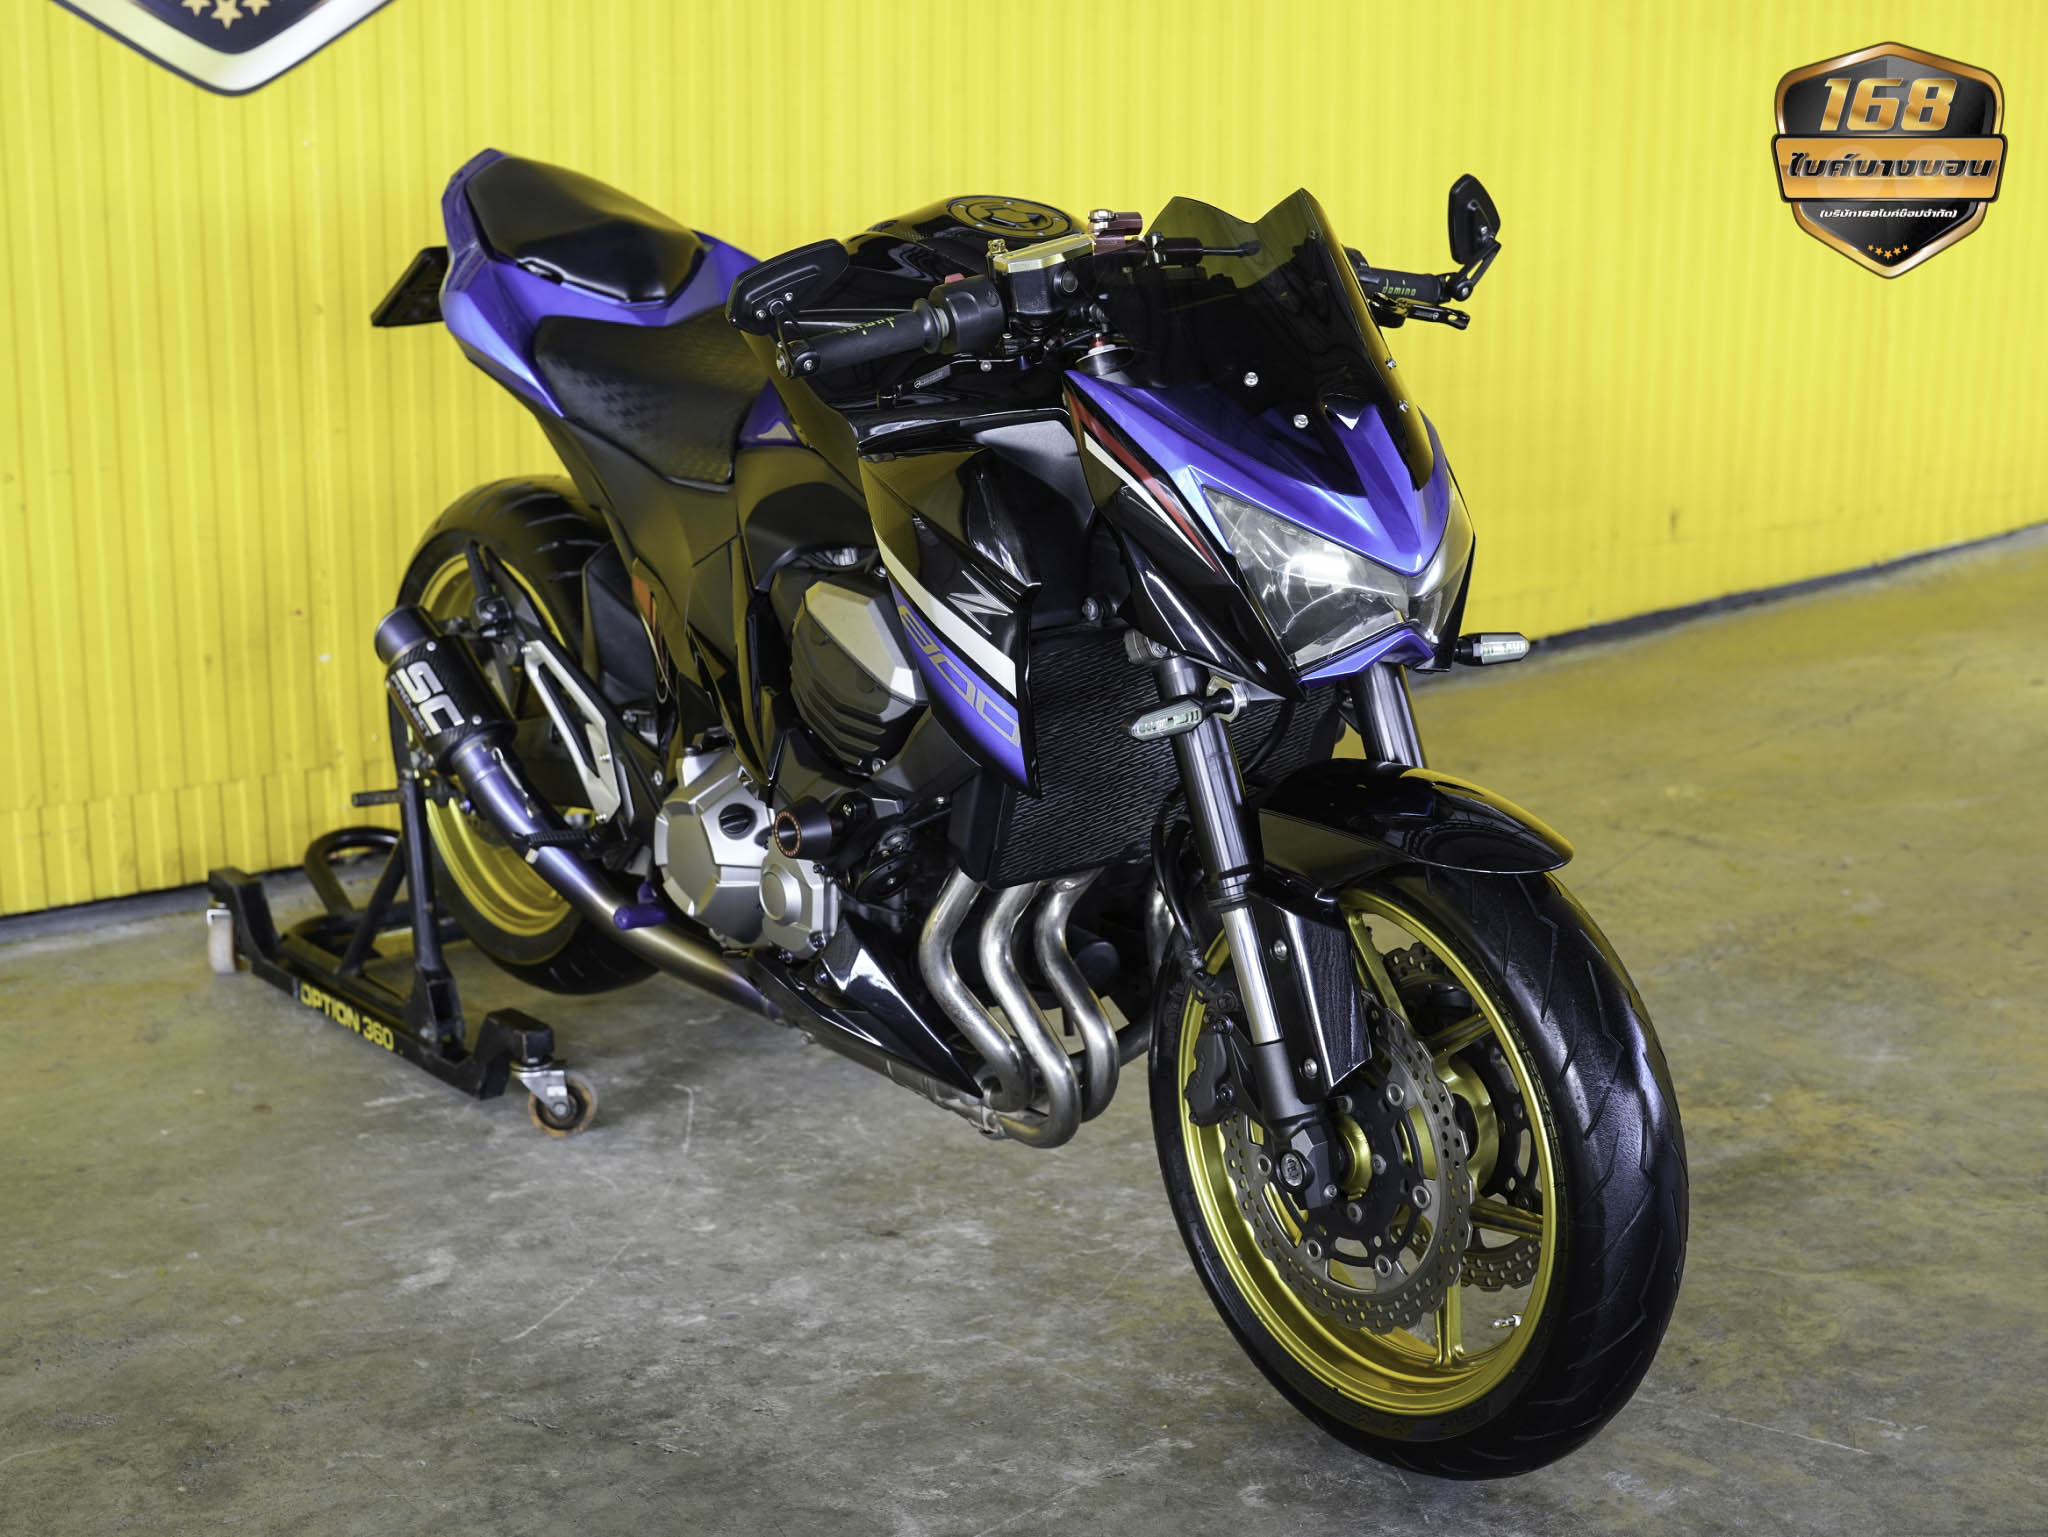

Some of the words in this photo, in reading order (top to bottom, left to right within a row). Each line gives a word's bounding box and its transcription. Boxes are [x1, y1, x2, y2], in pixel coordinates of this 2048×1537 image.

[1382, 278, 1417, 296] domino
[396, 660, 465, 736] SC
[300, 983, 360, 1033] OPTION
[362, 1015, 395, 1051] 360
